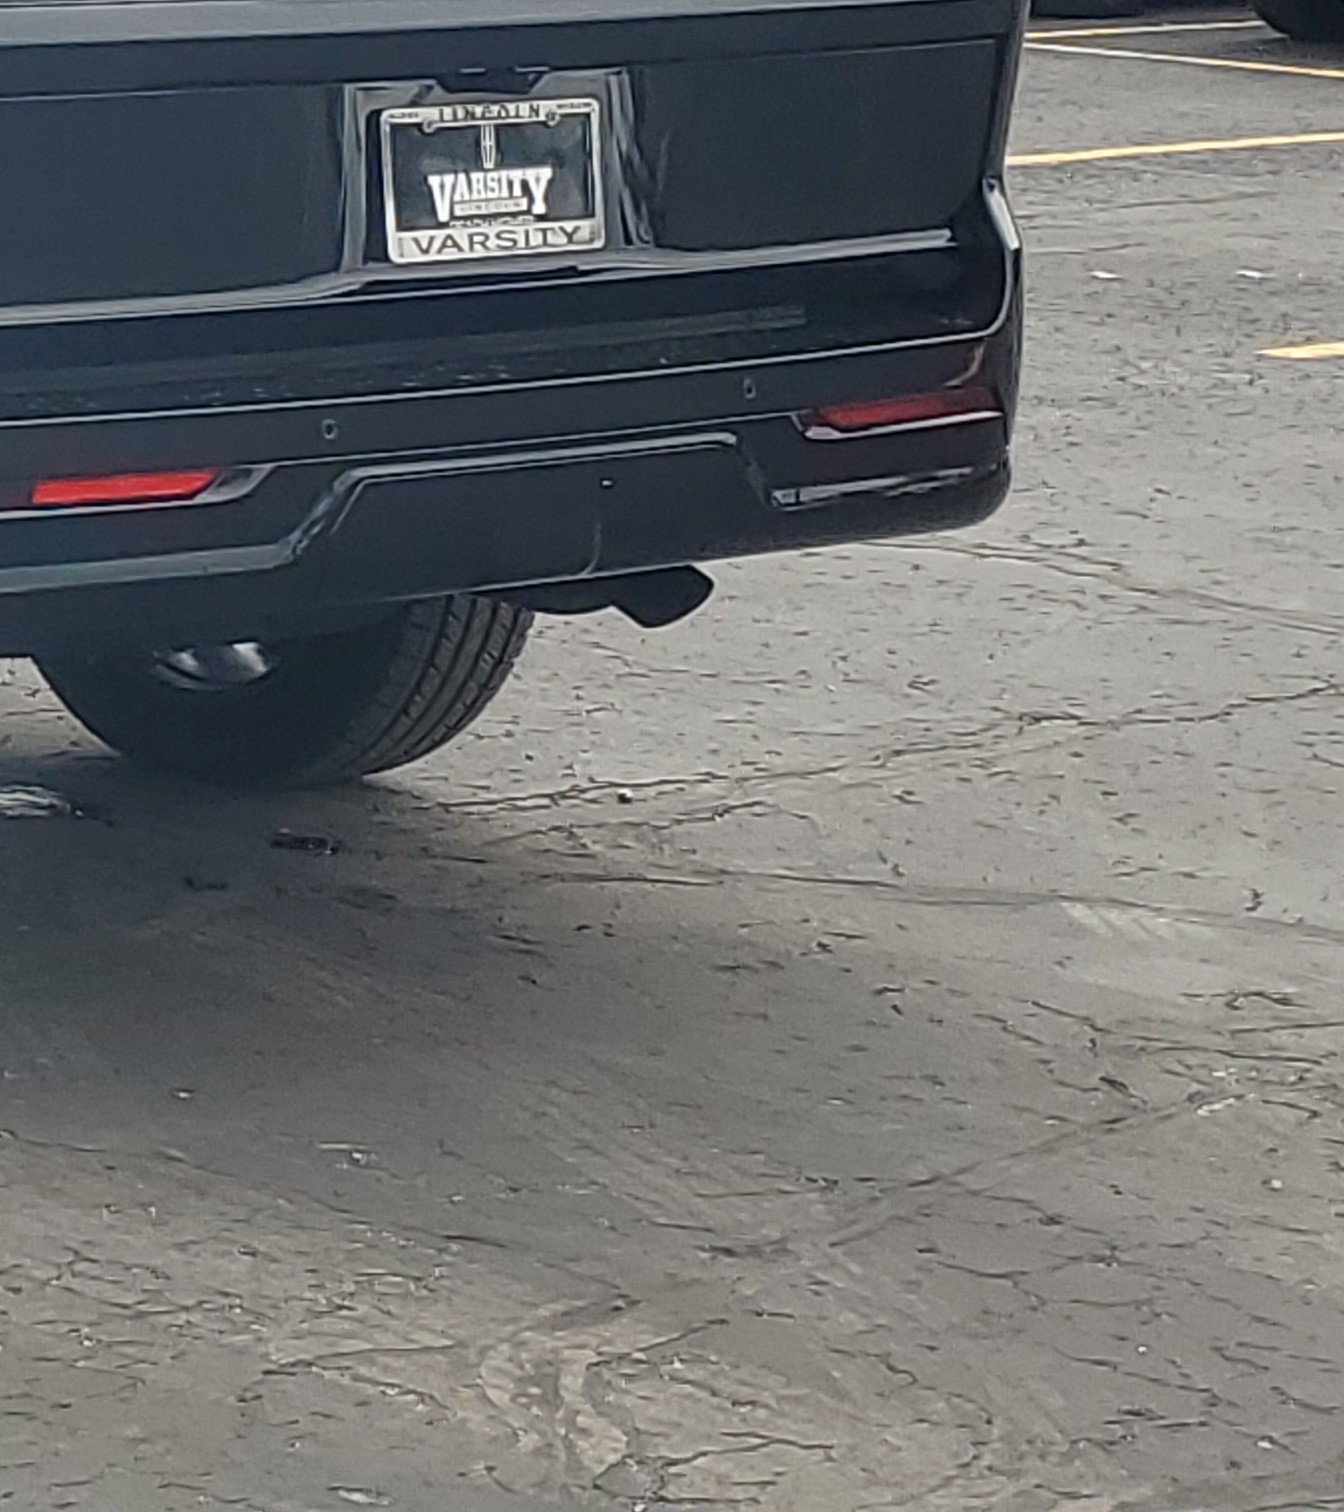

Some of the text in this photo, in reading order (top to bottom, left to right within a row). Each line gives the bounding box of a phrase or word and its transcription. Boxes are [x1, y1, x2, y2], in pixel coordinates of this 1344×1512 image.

[439, 103, 540, 123] LINCOLN
[427, 167, 553, 223] VARSITY
[413, 227, 581, 255] VARSITY
